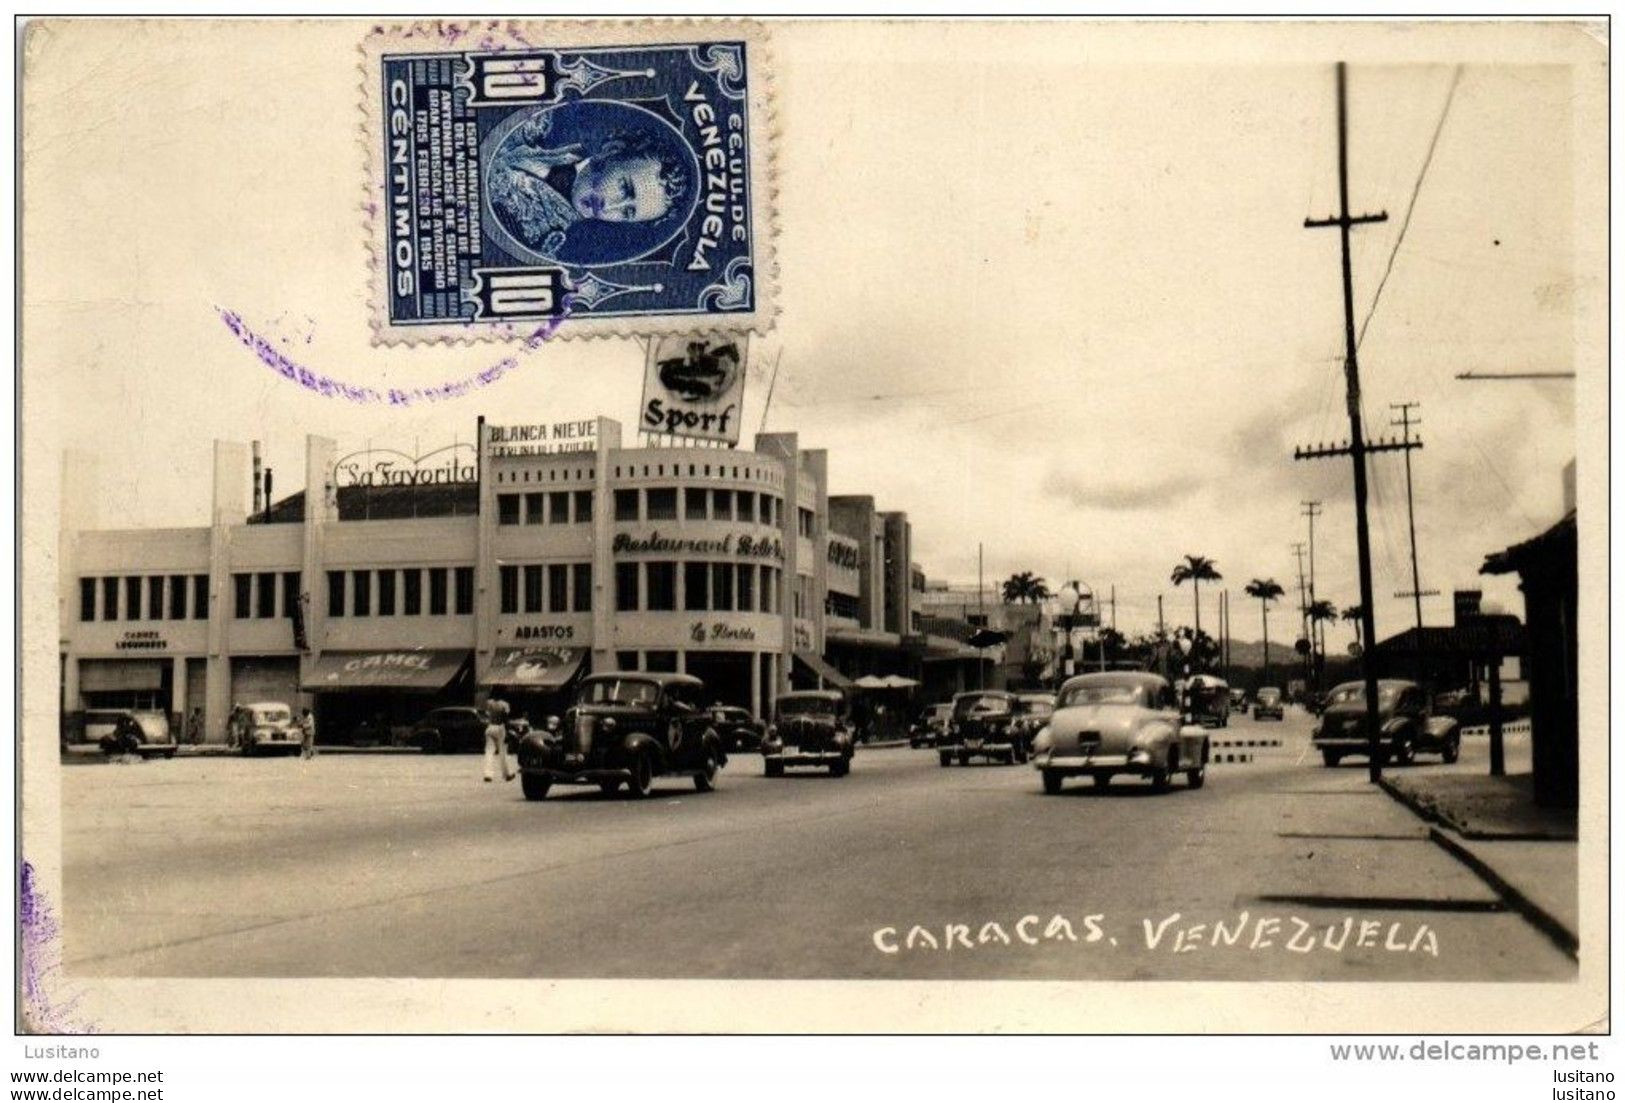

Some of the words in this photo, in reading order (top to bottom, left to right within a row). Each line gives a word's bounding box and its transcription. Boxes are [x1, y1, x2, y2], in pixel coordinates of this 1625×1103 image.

[483, 58, 546, 97] 10
[429, 89, 440, 124] GRAN
[441, 90, 453, 157] ANTONIO
[416, 110, 428, 143] 1795
[454, 122, 465, 149] DEL
[430, 127, 442, 197] MARISCAL
[685, 80, 727, 271] VENEZUELA
[391, 79, 414, 298] CÉNTIMOS
[443, 160, 457, 204] JOSÉ
[432, 198, 443, 216] DE
[445, 208, 456, 230] DE
[467, 159, 480, 254] ANIVERSARIO
[420, 220, 431, 230] 3
[421, 236, 433, 271] 1945
[433, 218, 446, 289] AYACUCHO
[446, 234, 457, 287] SUCRE
[458, 236, 468, 254] DE
[490, 274, 553, 313] 10
[491, 425, 547, 442] BLANCA
[553, 420, 597, 439] NIEVE
[644, 398, 735, 433] Sport
[375, 458, 475, 487] Favorita
[612, 530, 732, 554] Restaurant
[515, 625, 573, 639] ABASTOS
[344, 653, 433, 671] CAMEL
